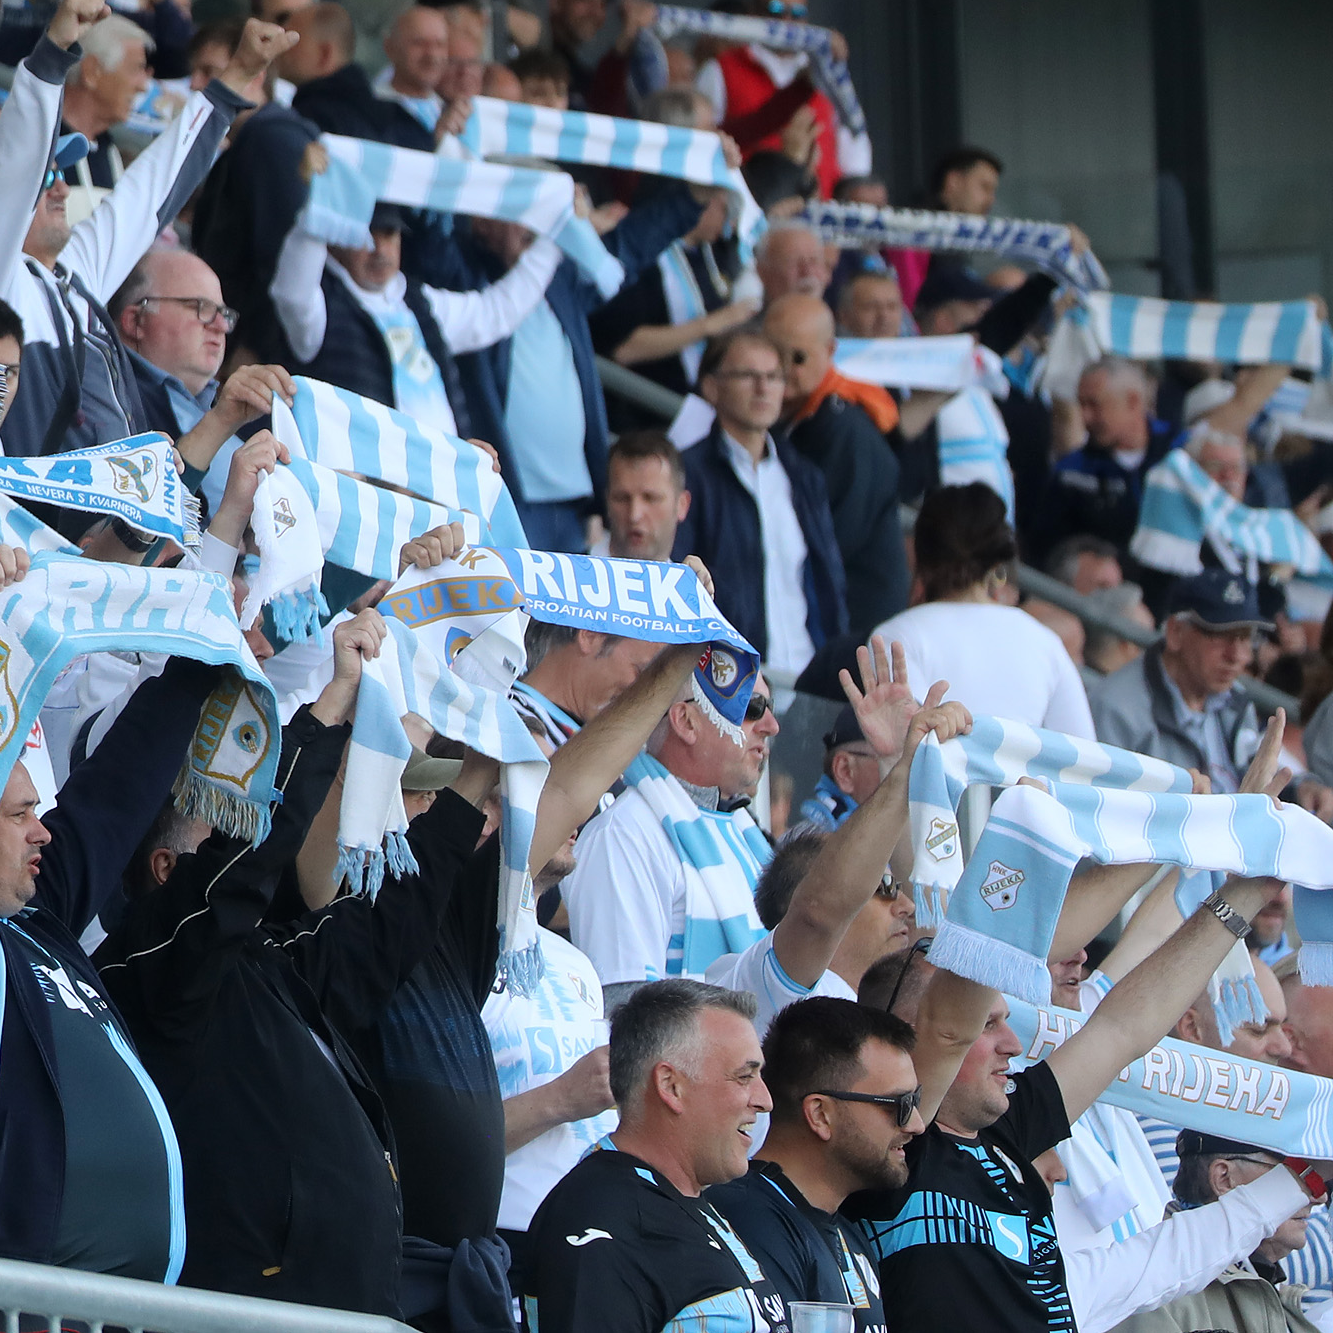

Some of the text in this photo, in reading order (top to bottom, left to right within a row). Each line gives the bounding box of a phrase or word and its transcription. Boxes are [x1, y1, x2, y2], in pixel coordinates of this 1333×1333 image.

[26, 483, 75, 502] NEVERA
[78, 493, 86, 504] S
[88, 494, 144, 522] KVARNERA
[524, 596, 608, 622] CROATIAN
[611, 612, 702, 634] FOOTBALL
[983, 873, 1022, 896] RIJEKA
[991, 864, 1008, 877] HNK
[1140, 1046, 1292, 1121] RIJEKA
